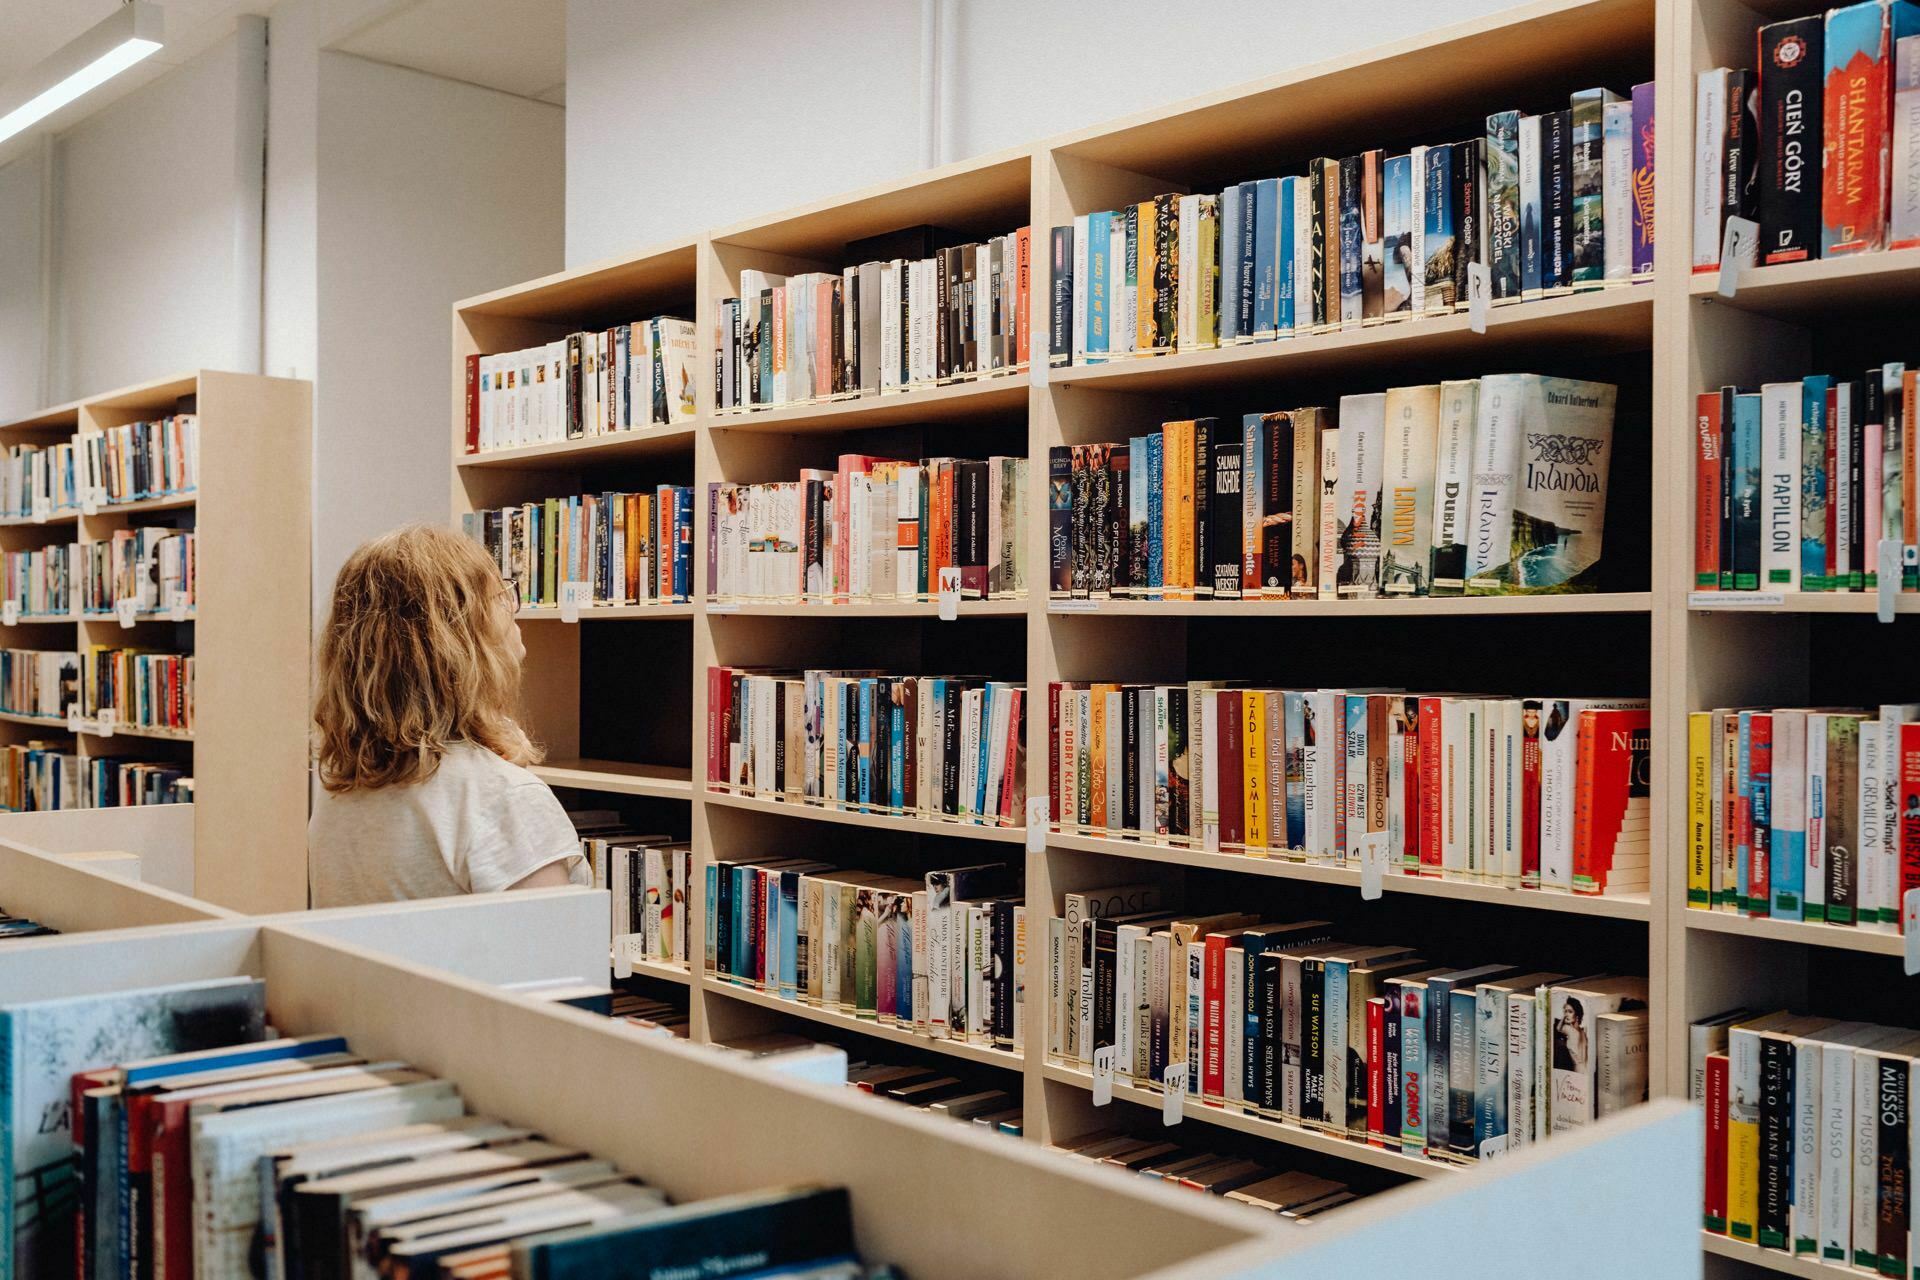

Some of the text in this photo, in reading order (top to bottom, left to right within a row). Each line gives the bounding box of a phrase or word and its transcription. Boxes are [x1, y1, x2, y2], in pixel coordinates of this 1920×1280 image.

[1552, 119, 1560, 209] MICHAEL RIDPATH
[1784, 90, 1804, 193] CIEŃ GÓRY
[1846, 77, 1866, 205] SHANTARAM
[1728, 149, 1739, 205] Krew marzeń
[1160, 204, 1168, 228] WĄŻ
[1463, 182, 1473, 244] Szklane Gejsze
[1493, 194, 1502, 263] NAUCZYCIEL
[1501, 205, 1512, 248] WŁOSKI
[1554, 216, 1561, 228] NA
[1128, 212, 1136, 280] STEF PENNEY
[1160, 243, 1168, 279] ESSEX
[1242, 261, 1252, 319] Powrót do domu
[655, 347, 661, 358] TA
[1216, 455, 1240, 468] SALMAN
[1700, 416, 1714, 460] BOURDIN
[1216, 471, 1241, 494] RUSHDIE
[1246, 425, 1258, 575] Salman Rushdie Quichotte
[1296, 461, 1304, 495] DZIECI
[1324, 503, 1334, 518] NIE
[1324, 522, 1334, 536] MA
[1393, 487, 1416, 546] LONDYN
[1773, 474, 1790, 552] PAPILLON
[1053, 526, 1062, 569] MOTYLI
[566, 586, 575, 603] H
[941, 575, 956, 593] M
[946, 708, 955, 749] McEwan
[970, 708, 978, 749] McEWAN
[1347, 731, 1356, 758] SZALAY
[1356, 734, 1364, 756] DAVID
[1064, 731, 1074, 815] DOBRY KŁAMCA
[1080, 772, 1087, 784] NA
[1248, 696, 1259, 839] ZADIE SMITH
[1271, 738, 1282, 837] Pod jednym dachem
[1305, 750, 1316, 811] Maugham
[1545, 769, 1553, 800] SIMON
[1696, 757, 1706, 815] LEPSZE ŻYCIE
[1033, 806, 1041, 826] S
[1348, 784, 1356, 817] CZŁOWIEK
[1375, 757, 1384, 828] OTHERHOOD
[1368, 842, 1375, 863] T
[1695, 822, 1704, 875] Anna Gavalda
[1754, 828, 1763, 882] Anna Gavalda
[1830, 846, 1849, 900] Gounelle
[1068, 899, 1078, 942] ROSE
[940, 945, 948, 998] MONTEFIORE
[954, 933, 962, 971] MORGAN
[973, 928, 983, 971] mostert
[1080, 972, 1093, 1021] Trollope
[1140, 1014, 1149, 1039] Lalki
[1209, 1000, 1219, 1075] WALIZKA PANI SINCLAIR
[1311, 994, 1320, 1057] SUE WATSON
[1510, 1005, 1519, 1056] WILLETT
[1138, 1049, 1148, 1071] getta
[1265, 1046, 1274, 1105] SARAH WATERS
[1487, 1042, 1499, 1076] LIST
[1768, 1045, 1776, 1106] MUSSO
[1406, 1072, 1419, 1127] PORNO
[1882, 1067, 1897, 1126] MUSSO
[1769, 1117, 1778, 1160] ZIMNE
[1802, 1104, 1814, 1154] MUSSO
[1830, 1108, 1843, 1158] MUSSO
[1860, 1115, 1873, 1166] MUSSO
